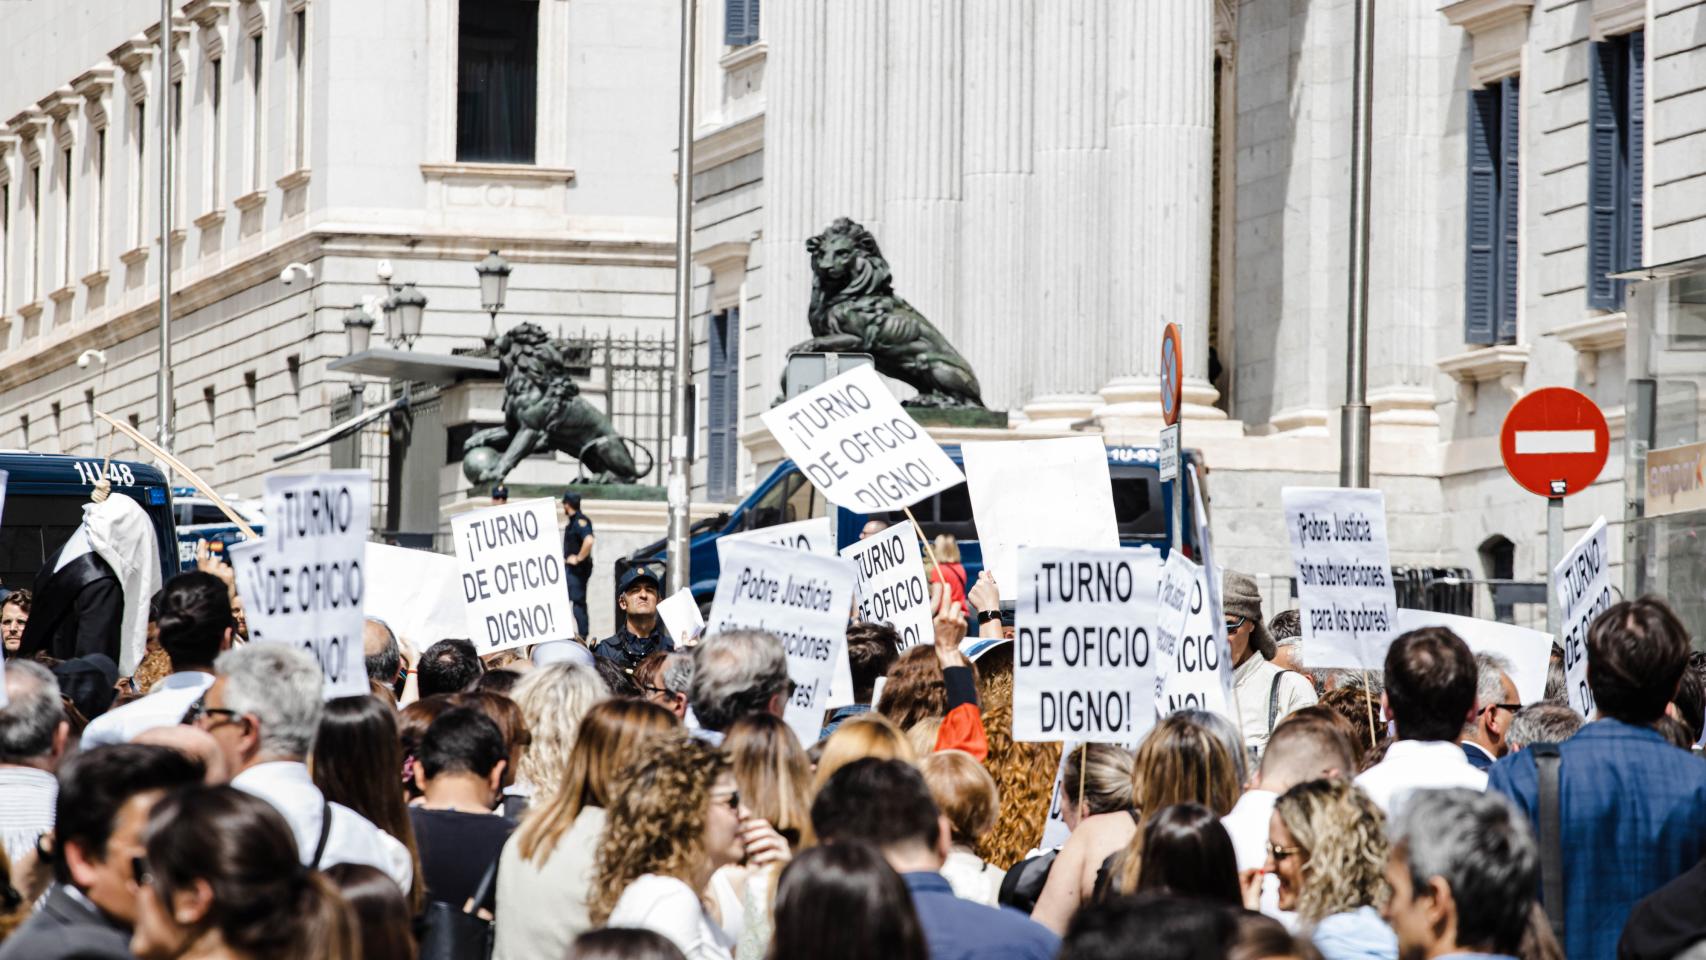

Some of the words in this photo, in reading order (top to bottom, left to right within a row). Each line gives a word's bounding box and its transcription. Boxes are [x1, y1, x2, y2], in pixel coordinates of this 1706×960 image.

[787, 384, 871, 450] ¡TURNO
[806, 451, 849, 489] DE
[839, 418, 917, 464] OFICIO
[854, 457, 941, 509] DIGNO!
[466, 510, 538, 562] ¡TURNO
[1297, 512, 1331, 549] ¡Pobre
[1331, 512, 1373, 543] Justicia
[297, 560, 363, 612] OFICIO
[462, 569, 491, 604] DE
[494, 554, 559, 595] OFICIO
[732, 566, 779, 605] ¡Pobre
[781, 574, 832, 612] Justicia
[1034, 562, 1132, 614] ¡TURNO
[1300, 556, 1318, 586] sin
[1317, 556, 1387, 588] subvenciones
[873, 576, 923, 622] OFICIO
[1310, 608, 1334, 639] para
[1332, 602, 1351, 632] los
[1350, 602, 1391, 640] pobres!
[485, 603, 556, 647] DIGNO!
[1019, 627, 1053, 668] DE
[1062, 626, 1149, 668] OFICIO
[1565, 626, 1582, 672] DE
[1040, 691, 1131, 733] DIGNO!
